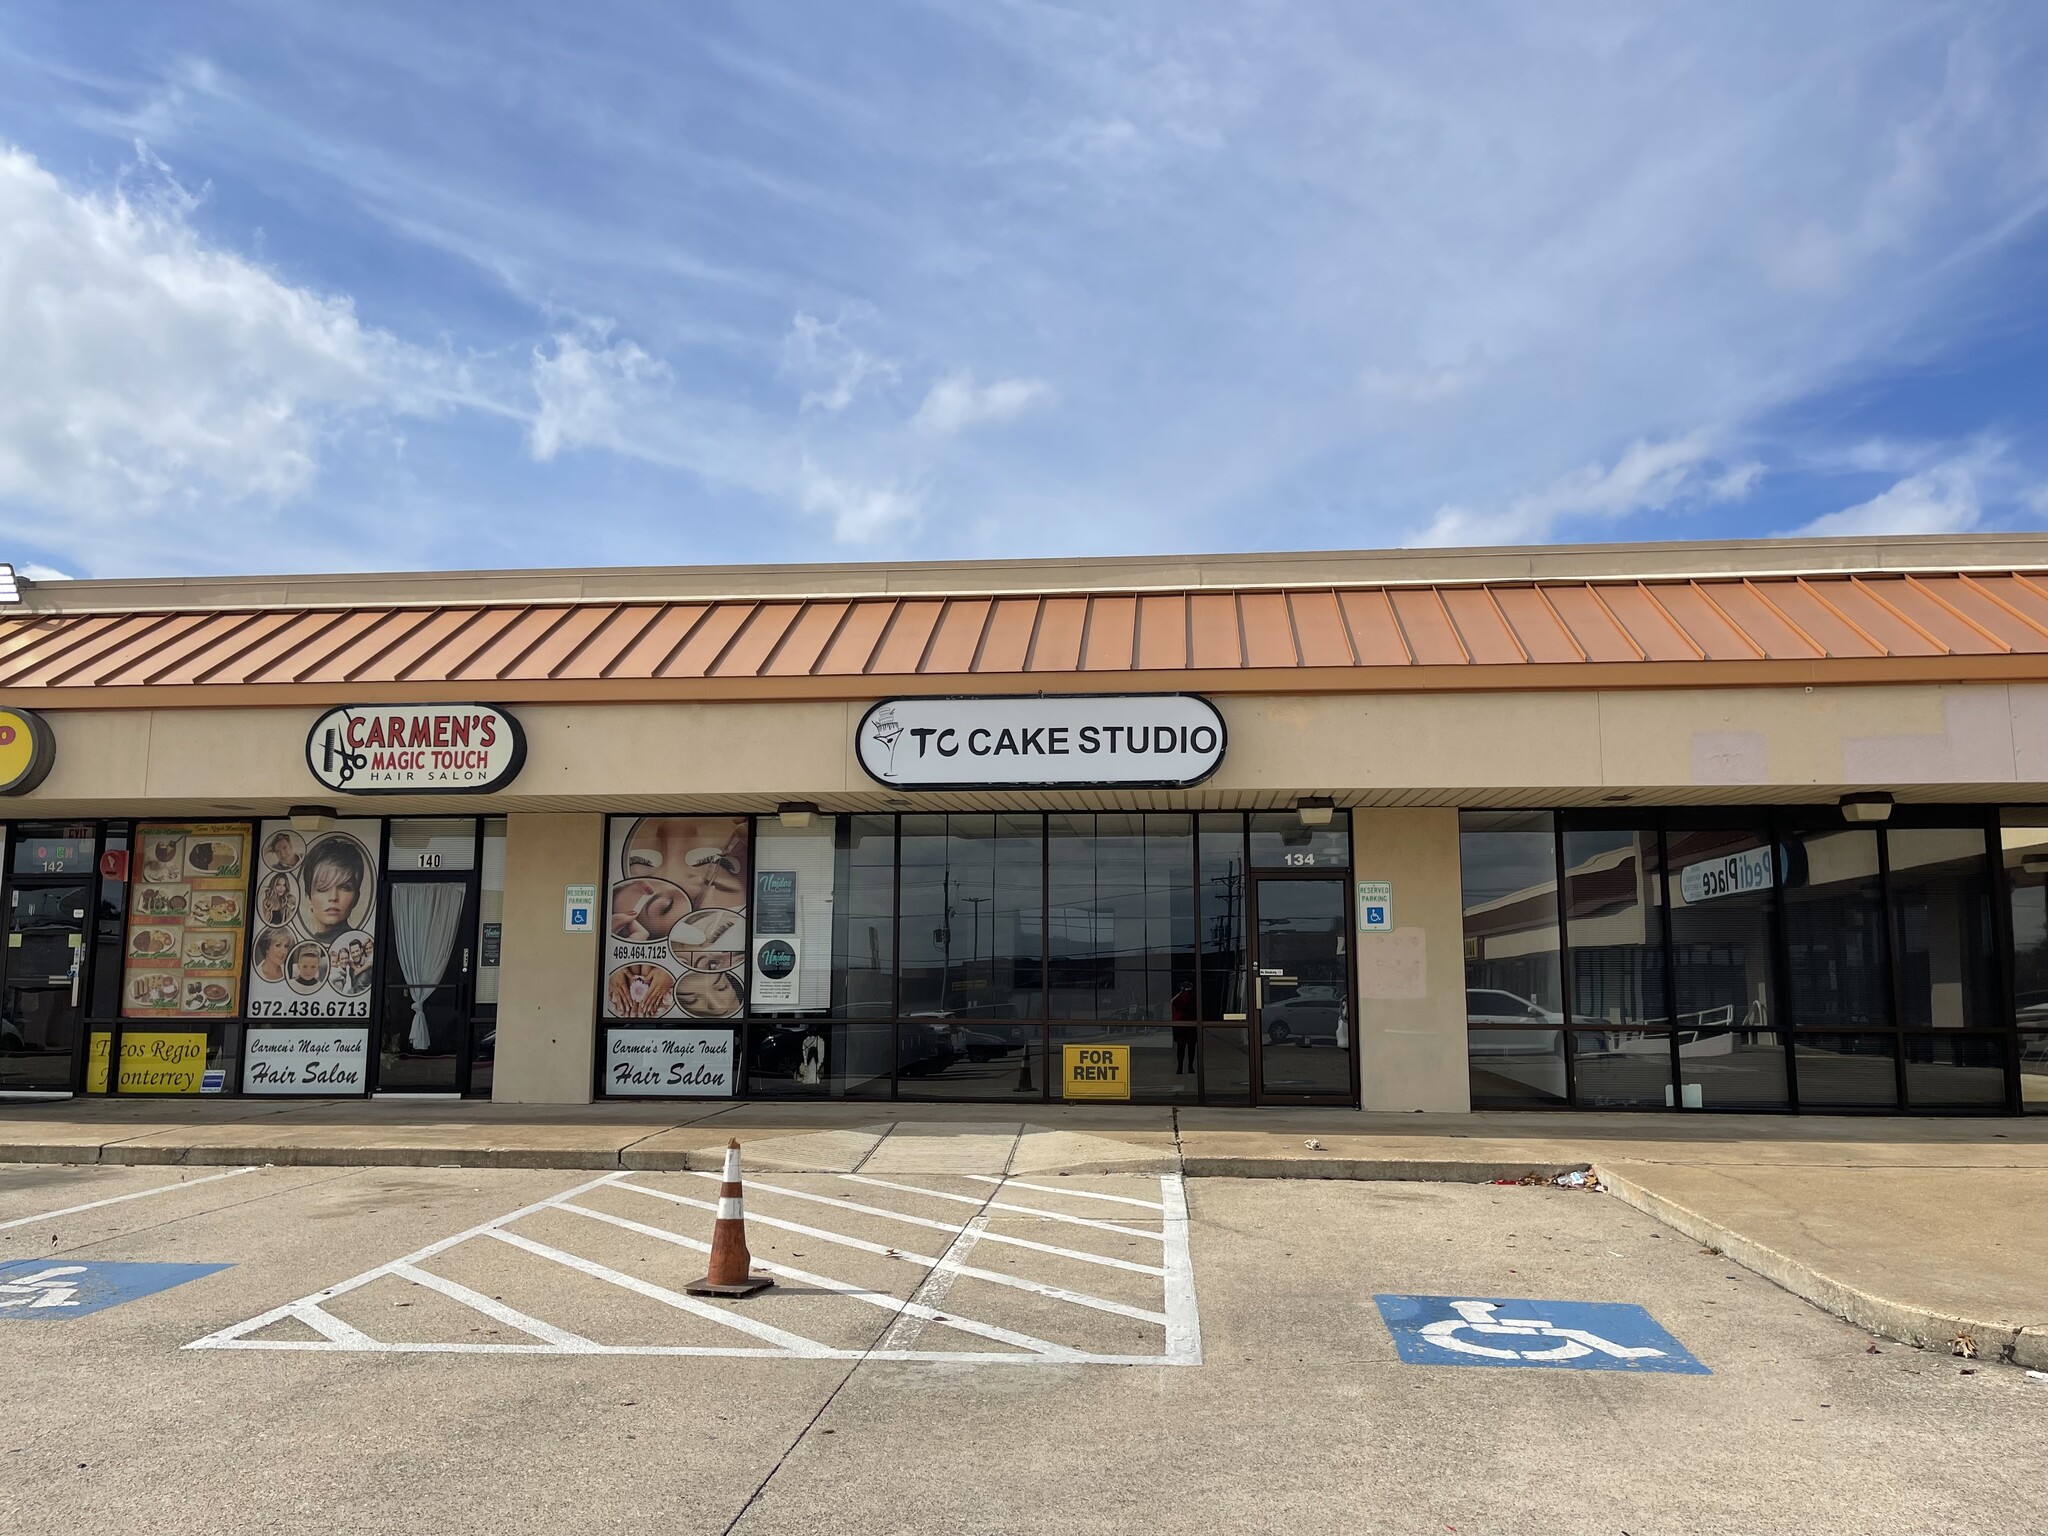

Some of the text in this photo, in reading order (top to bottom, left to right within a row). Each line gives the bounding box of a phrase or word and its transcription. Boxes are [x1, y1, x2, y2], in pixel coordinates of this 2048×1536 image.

[346, 715, 496, 748] CARMEN'S
[910, 725, 1217, 757] TC CAKE STUDIO
[371, 750, 488, 770] MAGIC TOUCH
[371, 771, 487, 781] HAIR SALON
[37, 847, 73, 858] OEN
[1284, 853, 1315, 866] 134
[42, 861, 64, 872] 142
[419, 854, 441, 868] 140
[759, 873, 792, 892] Unidos
[613, 946, 667, 959] 469.464.7125
[252, 1001, 367, 1017] 972.436.6713
[96, 1039, 200, 1064] Tcos Regio
[251, 1039, 362, 1056] Carmen's Magic Touch
[612, 1039, 728, 1057] Carmen's Magic Touch
[1079, 1050, 1113, 1064] FOR
[250, 1061, 358, 1084] Hair Salon
[613, 1062, 725, 1086] Hair Salon
[1074, 1066, 1119, 1080] RENT
